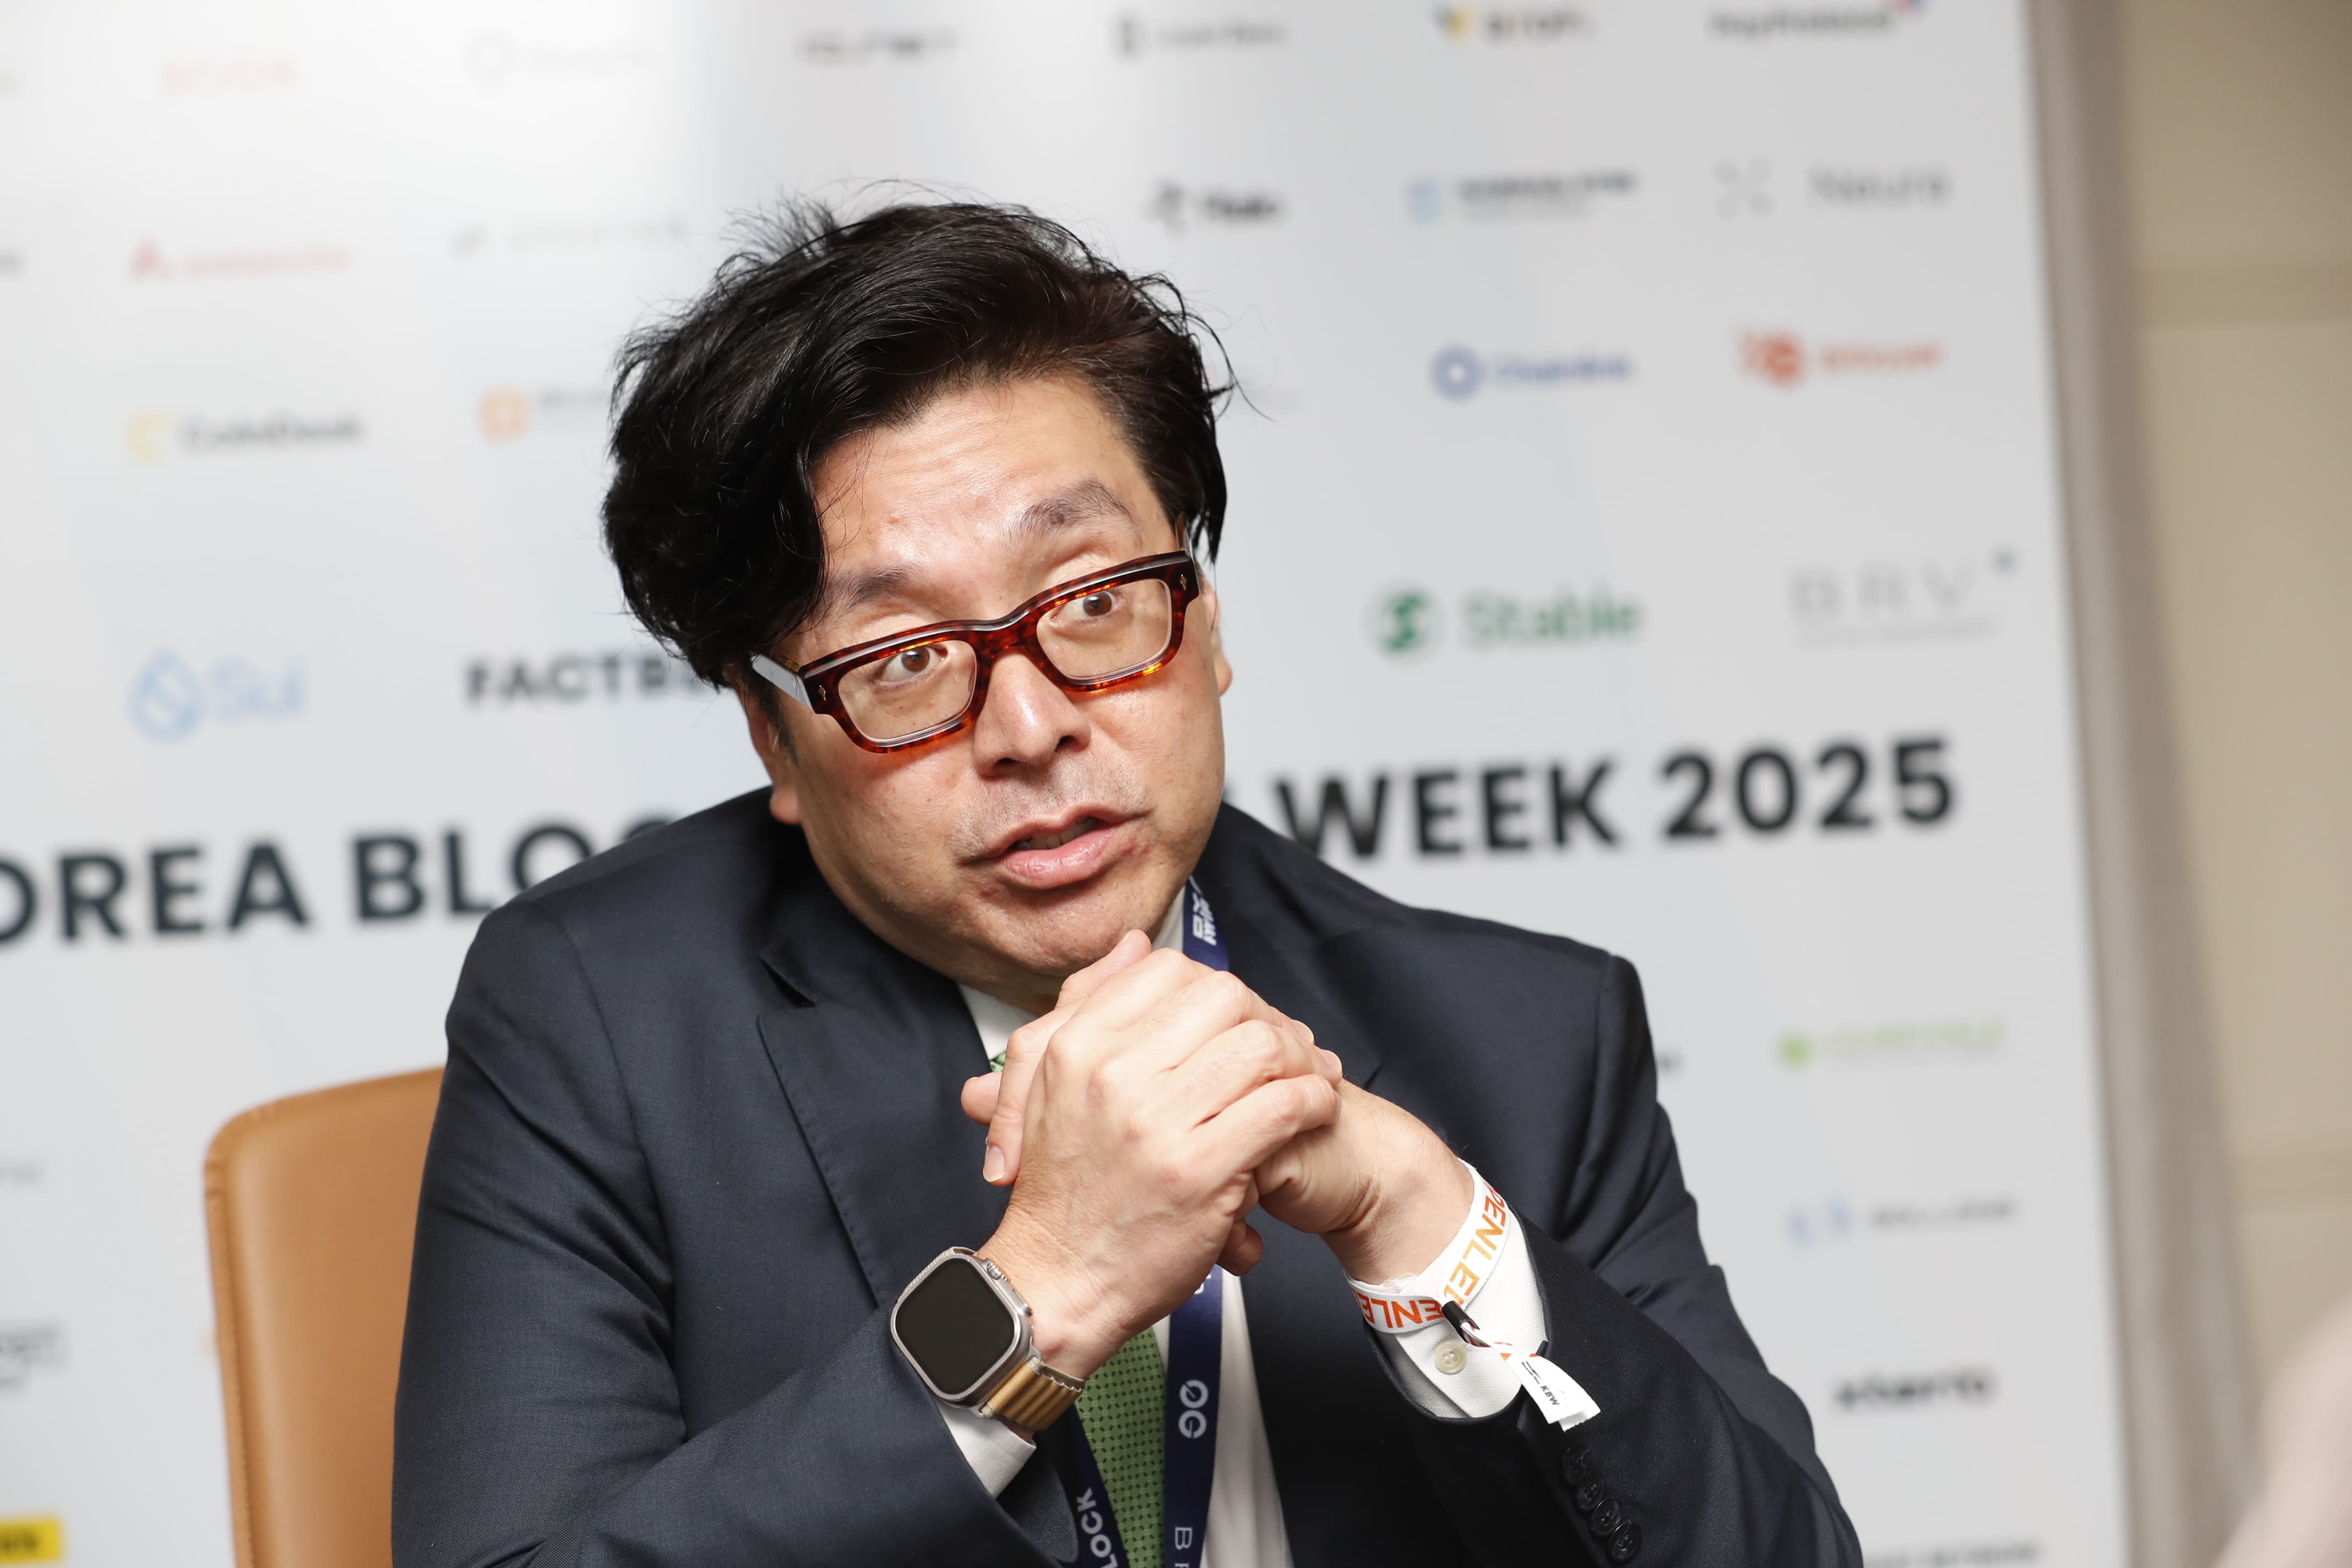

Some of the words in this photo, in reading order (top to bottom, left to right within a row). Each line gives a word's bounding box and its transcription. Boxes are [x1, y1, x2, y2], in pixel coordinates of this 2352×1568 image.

[1461, 590, 1642, 648] Stable
[208, 657, 309, 724] Sui
[1274, 760, 1618, 860] WEEK
[1659, 736, 1956, 843] 2025
[1541, 1385, 1560, 1405] KBW
